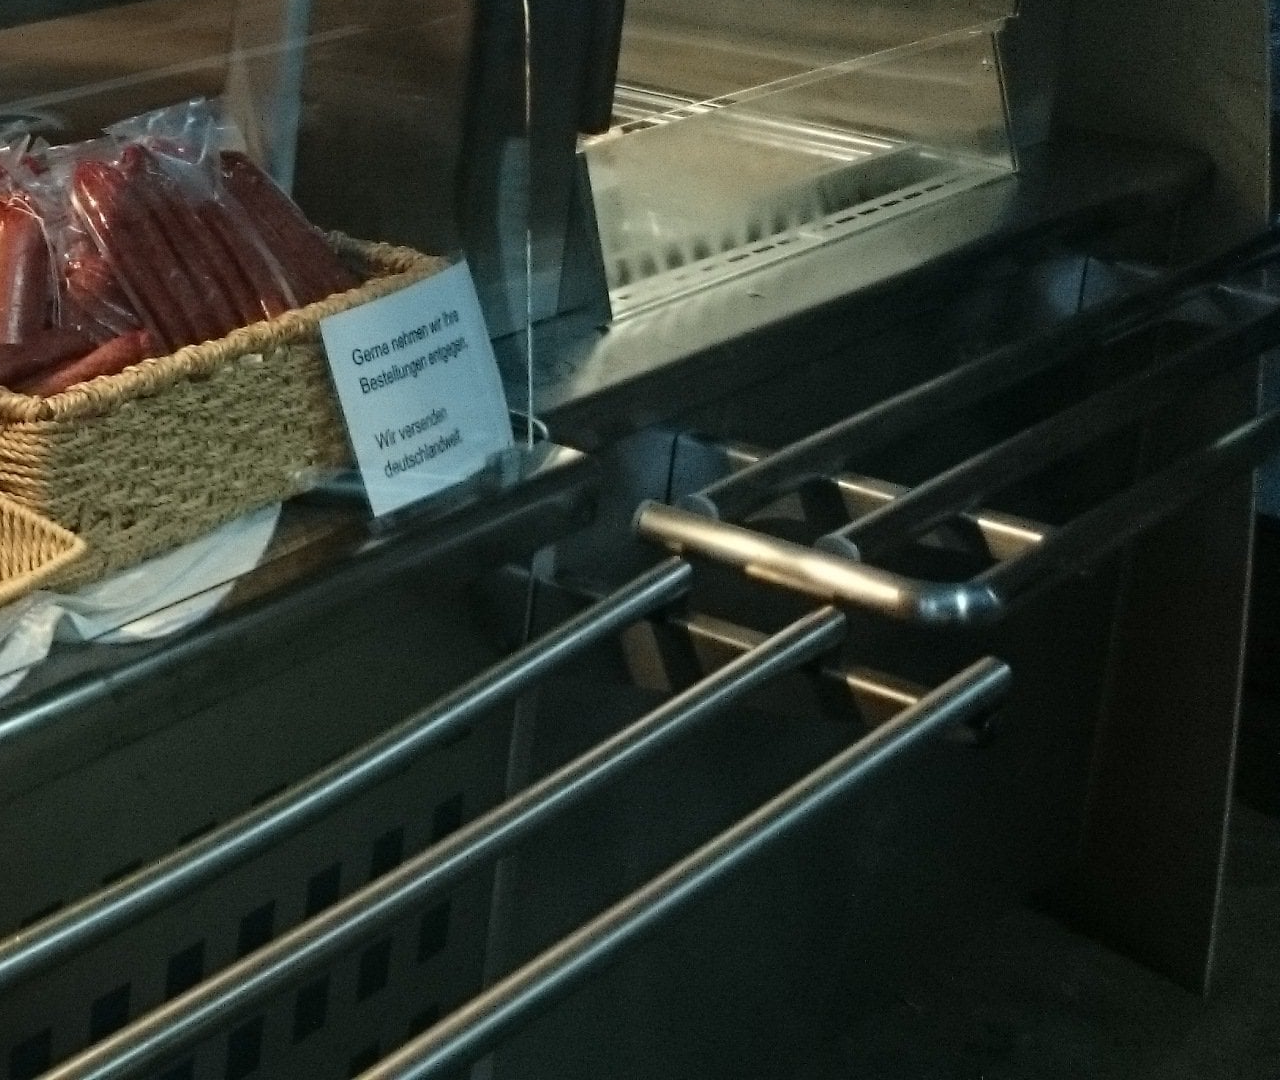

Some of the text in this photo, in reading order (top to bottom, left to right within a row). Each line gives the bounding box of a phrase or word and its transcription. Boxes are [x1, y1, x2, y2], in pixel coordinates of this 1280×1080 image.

[352, 343, 390, 365] Gerne
[391, 325, 428, 350] nehmen
[430, 318, 442, 333] wir
[359, 356, 428, 394] Bestellungen
[375, 408, 447, 450] Wir versenden
